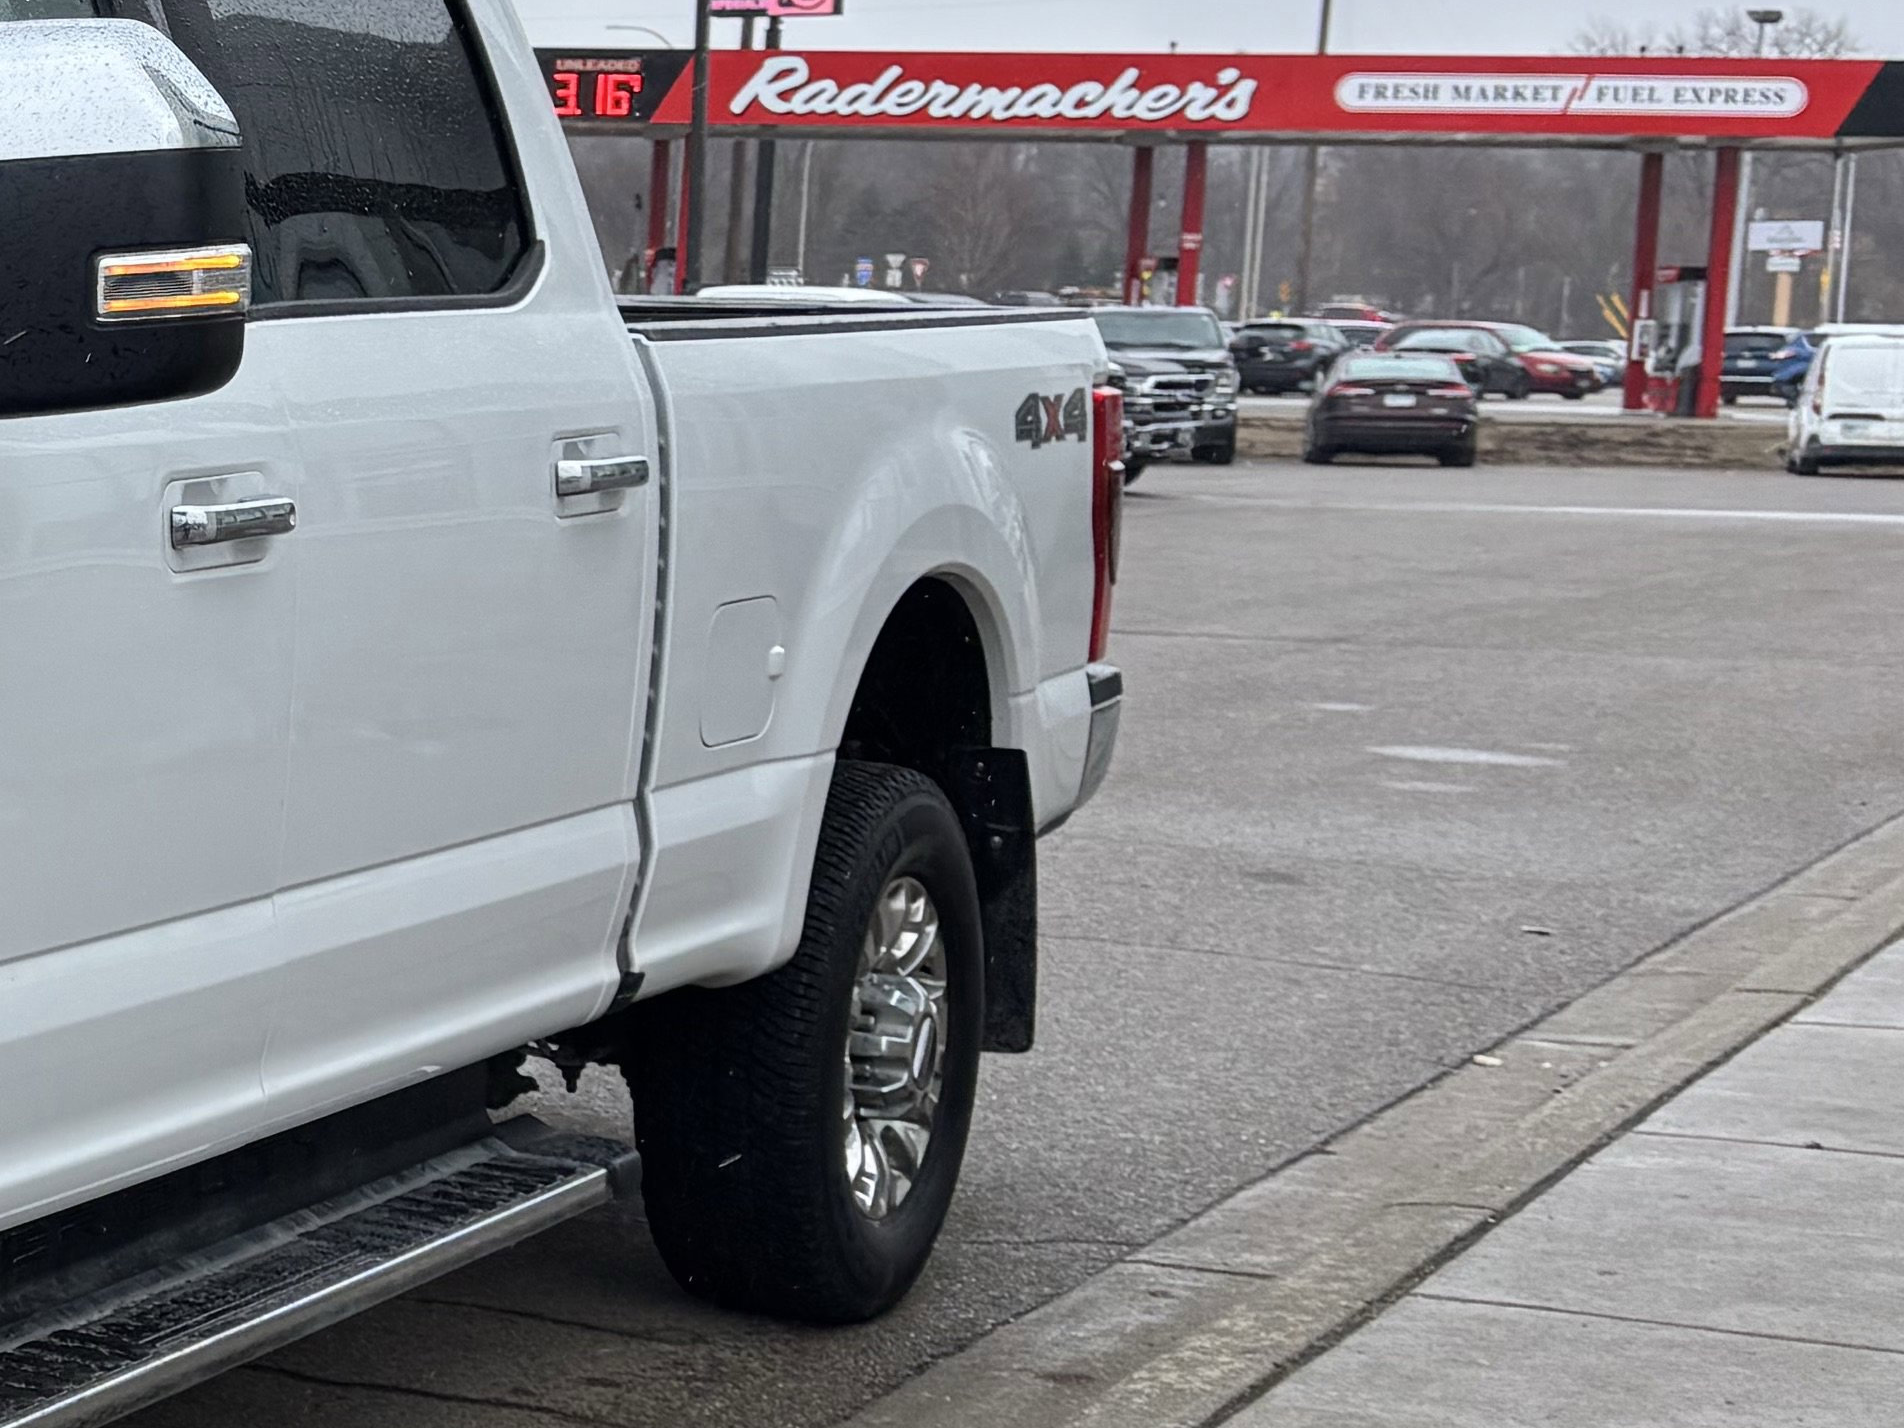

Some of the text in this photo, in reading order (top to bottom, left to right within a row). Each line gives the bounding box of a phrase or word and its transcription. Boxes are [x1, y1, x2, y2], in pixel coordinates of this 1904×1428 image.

[556, 58, 642, 72] UNLEADED
[728, 56, 1258, 121] Radermacher's
[1356, 81, 1788, 107] FRESH MARKET FUEL EXPRESS
